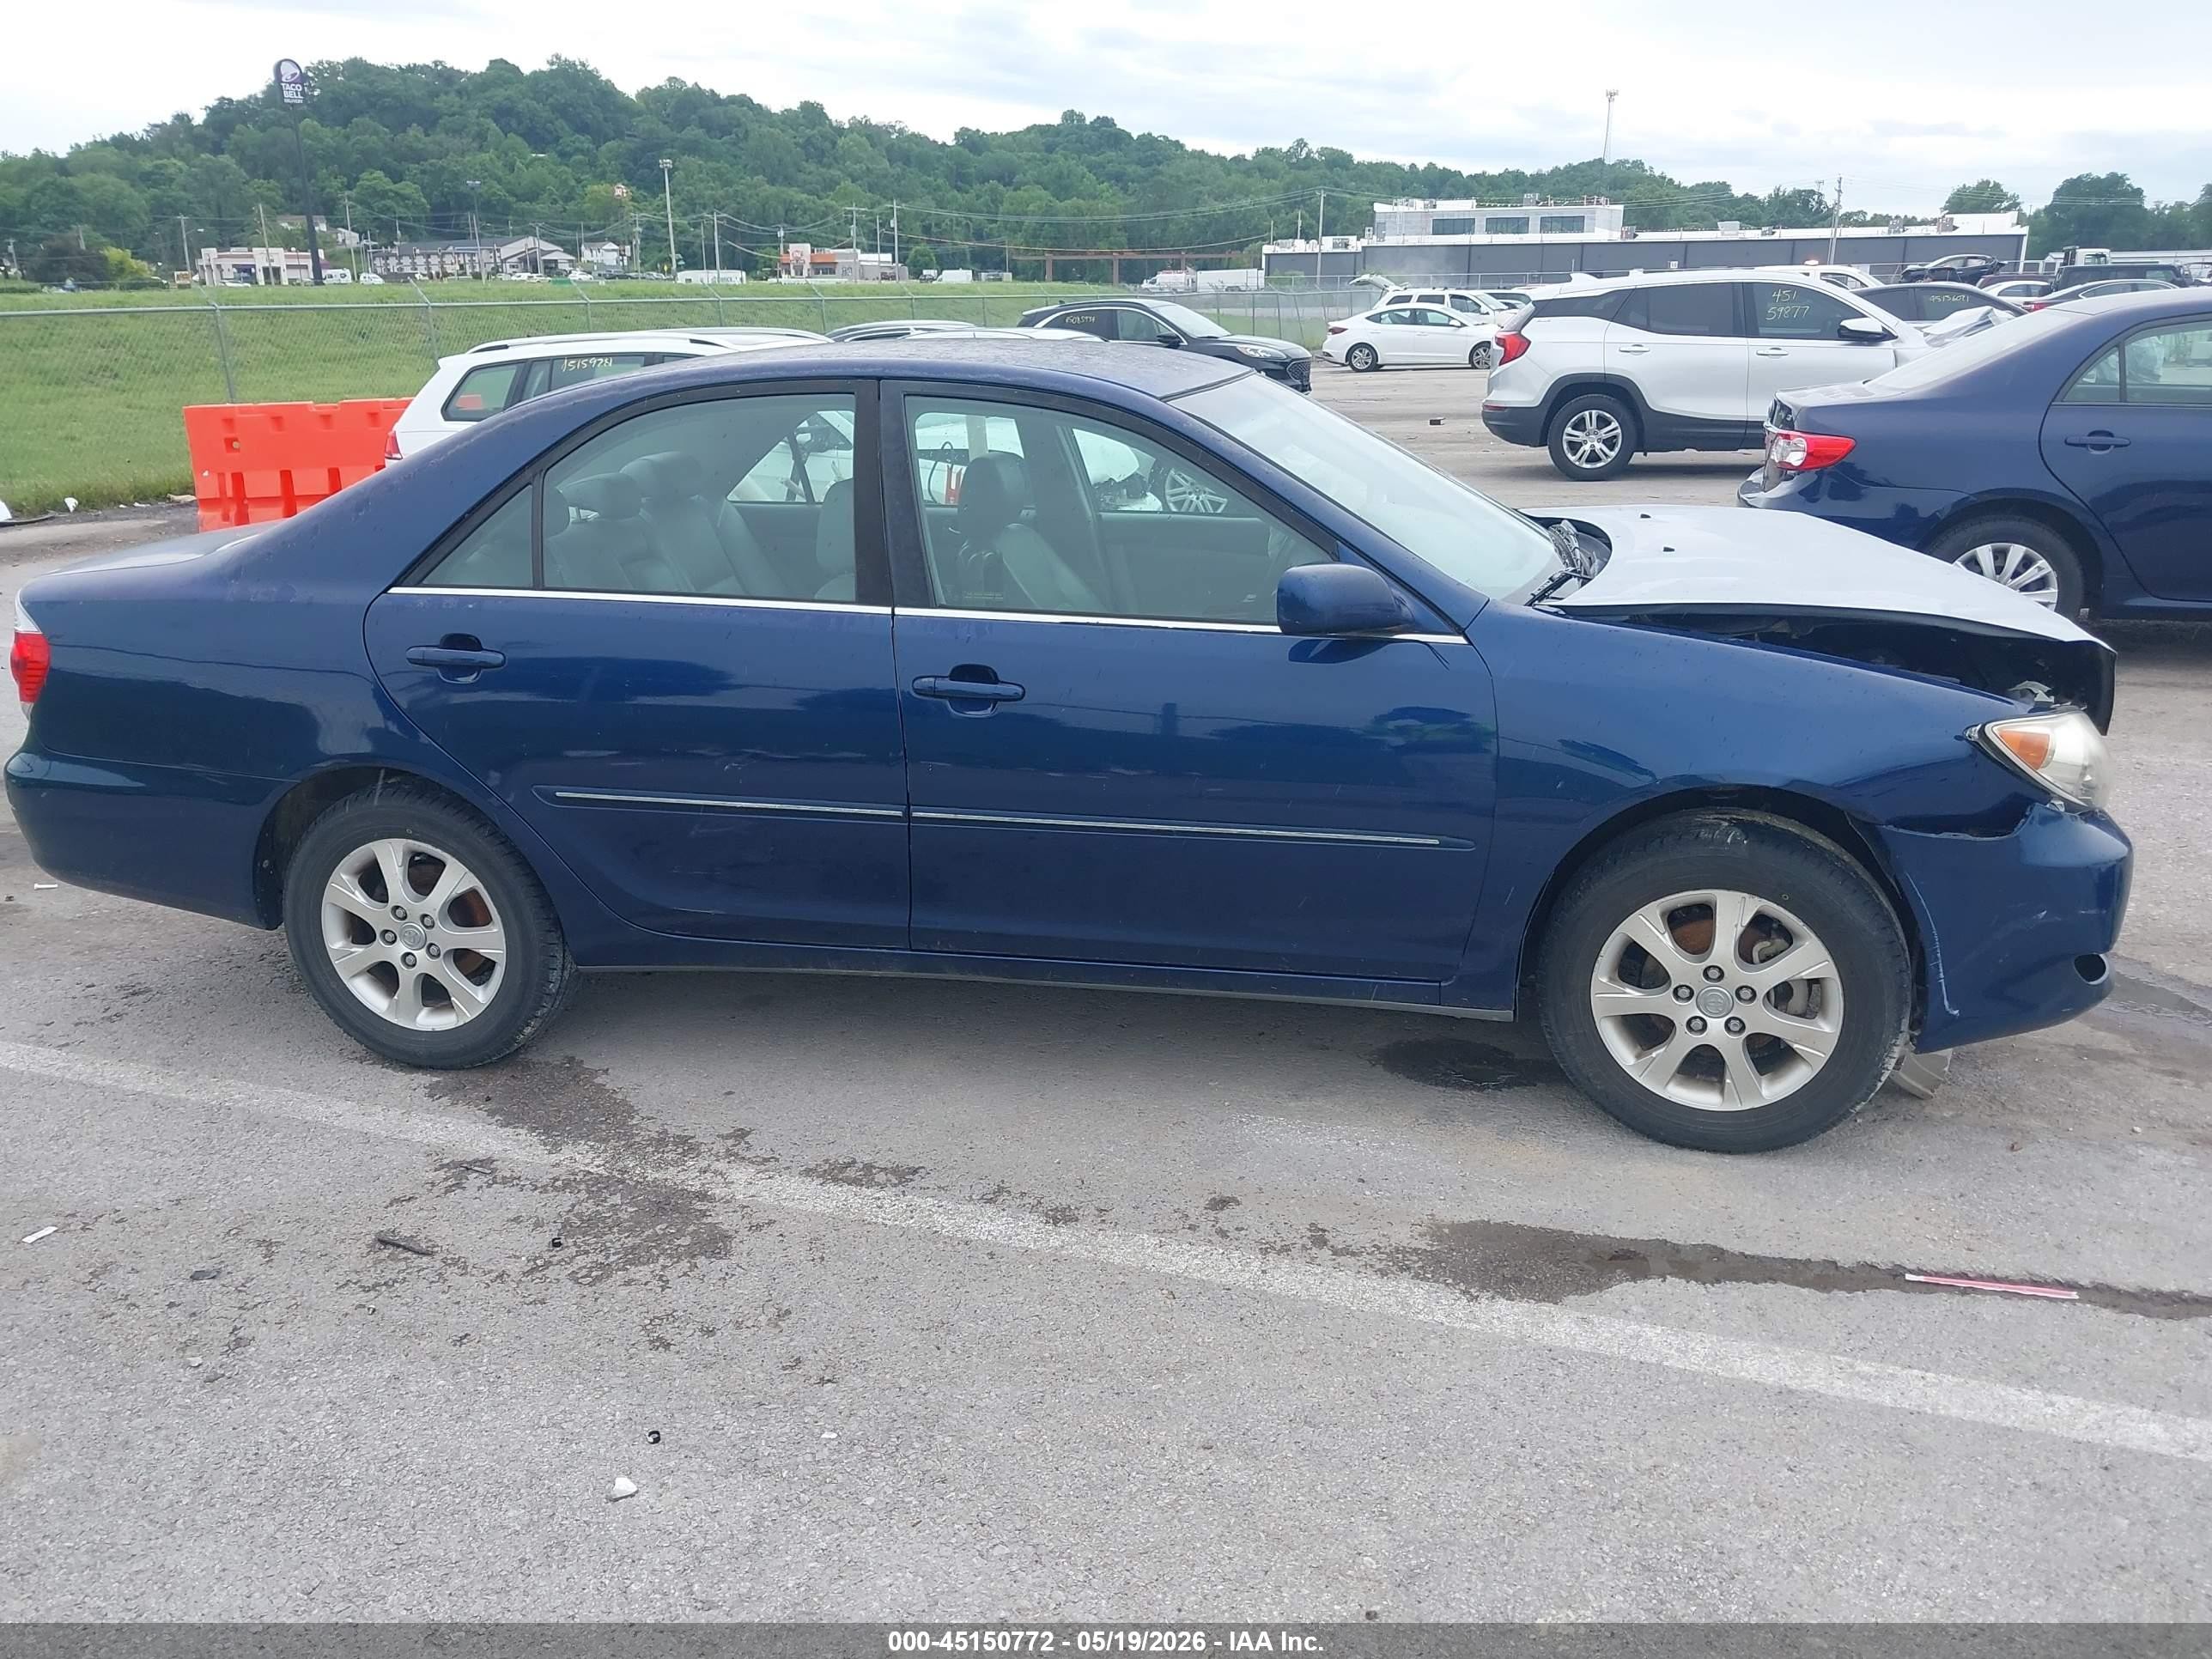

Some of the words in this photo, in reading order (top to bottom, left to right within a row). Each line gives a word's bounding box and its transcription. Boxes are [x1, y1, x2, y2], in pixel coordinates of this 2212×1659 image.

[283, 90, 304, 99] BELL
[1772, 289, 1797, 303] 451
[1765, 305, 1810, 320] 59877
